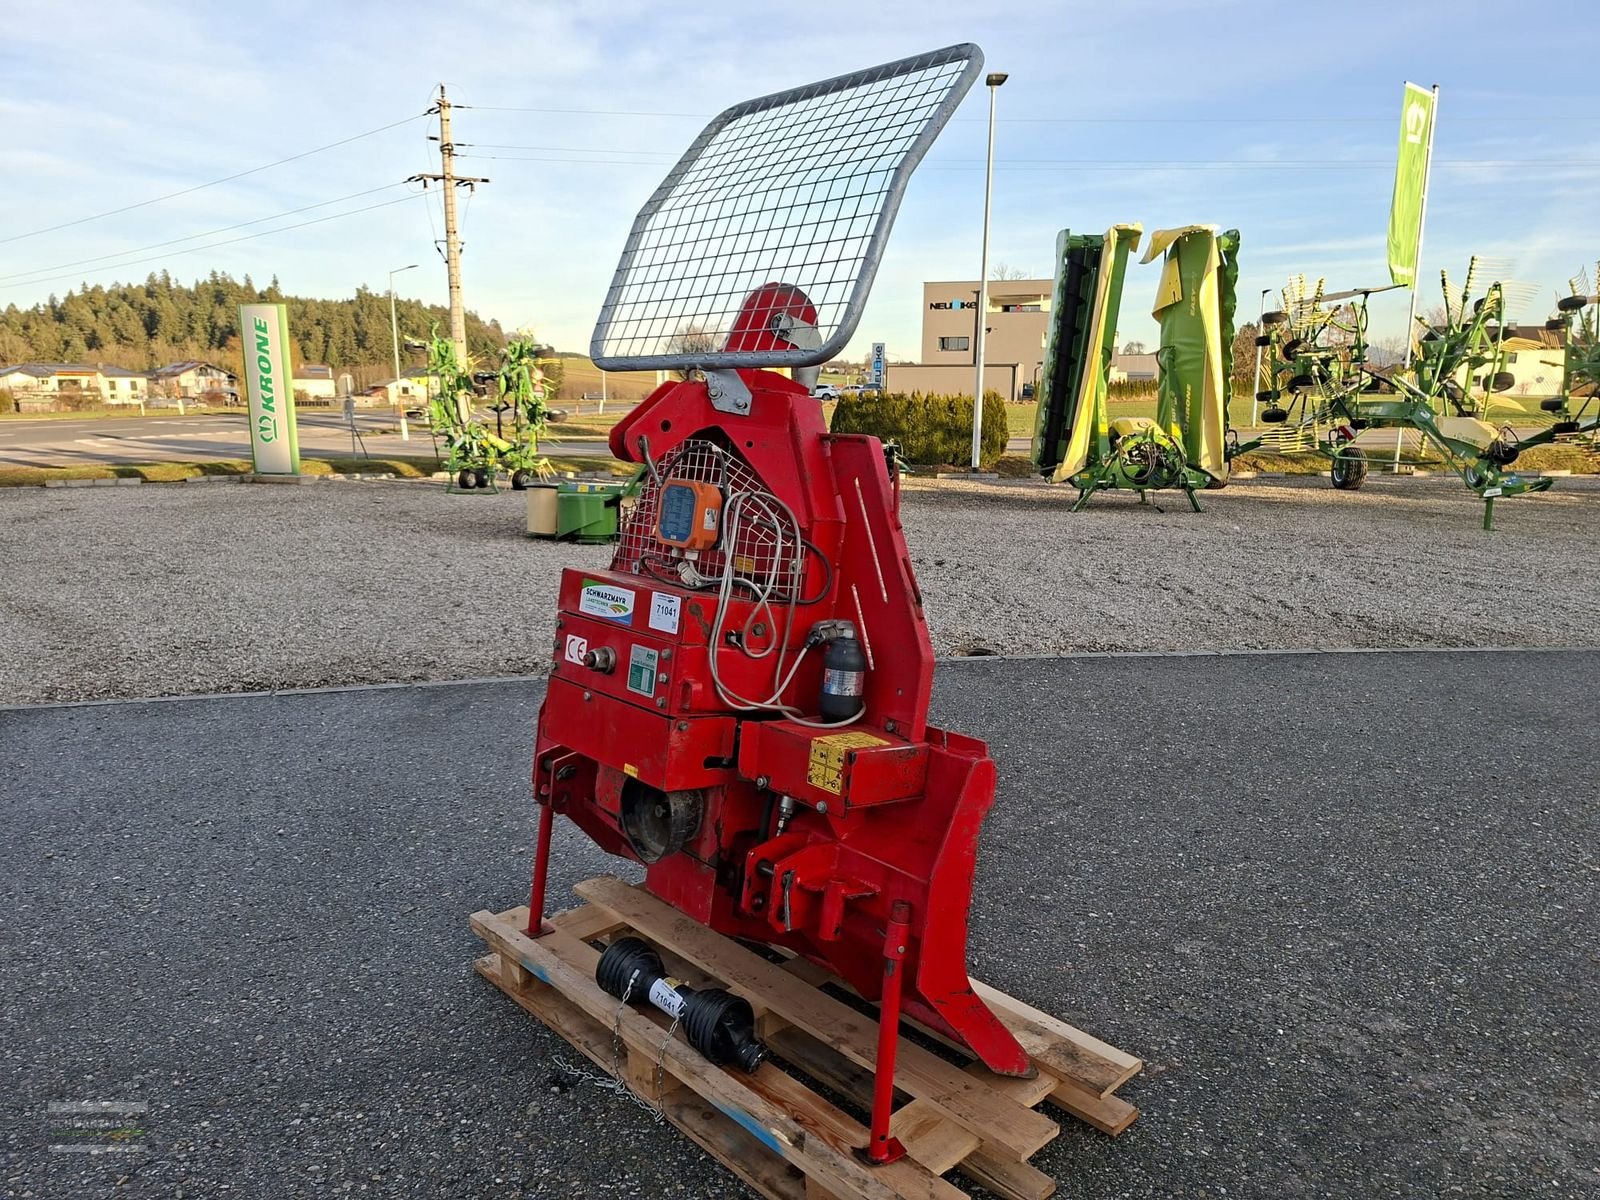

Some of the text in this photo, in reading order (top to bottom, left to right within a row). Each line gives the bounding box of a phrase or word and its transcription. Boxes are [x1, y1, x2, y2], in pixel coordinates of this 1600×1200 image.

[254, 317, 275, 413] KRONE
[586, 587, 627, 605] SCHWARZMAYR
[656, 604, 677, 617] 71041
[655, 991, 675, 1012] 71041
